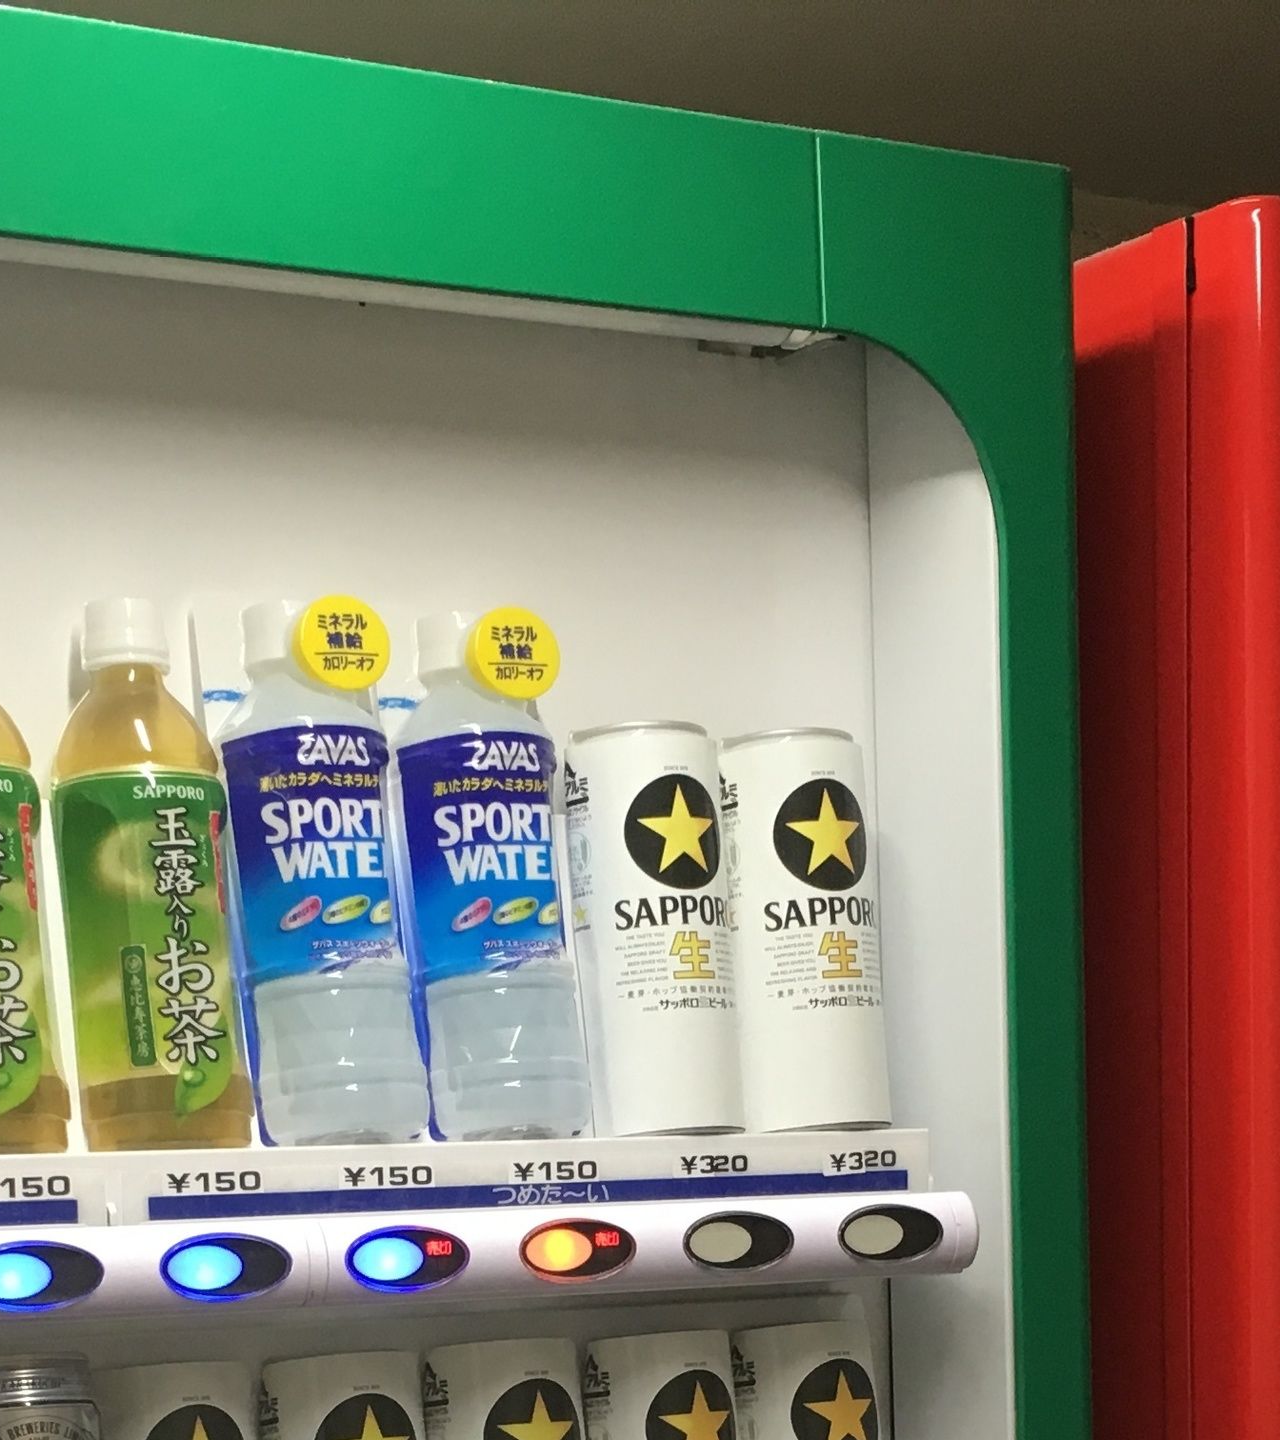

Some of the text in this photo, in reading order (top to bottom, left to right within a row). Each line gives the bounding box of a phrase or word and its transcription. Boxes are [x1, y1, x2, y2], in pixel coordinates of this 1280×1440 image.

[317, 613, 367, 630] ミネラル
[326, 631, 363, 650] 補給
[490, 626, 537, 642] ミネラル
[498, 643, 532, 661] 補給
[322, 655, 375, 671] カロリーオフ
[494, 665, 544, 682] カロリーオフ
[133, 783, 204, 801] SAPPORO
[271, 840, 388, 885] WATE
[443, 842, 556, 886] WATE
[670, 931, 715, 979] 生
[818, 931, 862, 979] 生
[514, 1160, 597, 1181] ¥150
[680, 1154, 748, 1176] ¥320
[831, 1149, 896, 1171] ¥320
[168, 1170, 261, 1194] ¥150
[344, 1165, 432, 1187] ¥150
